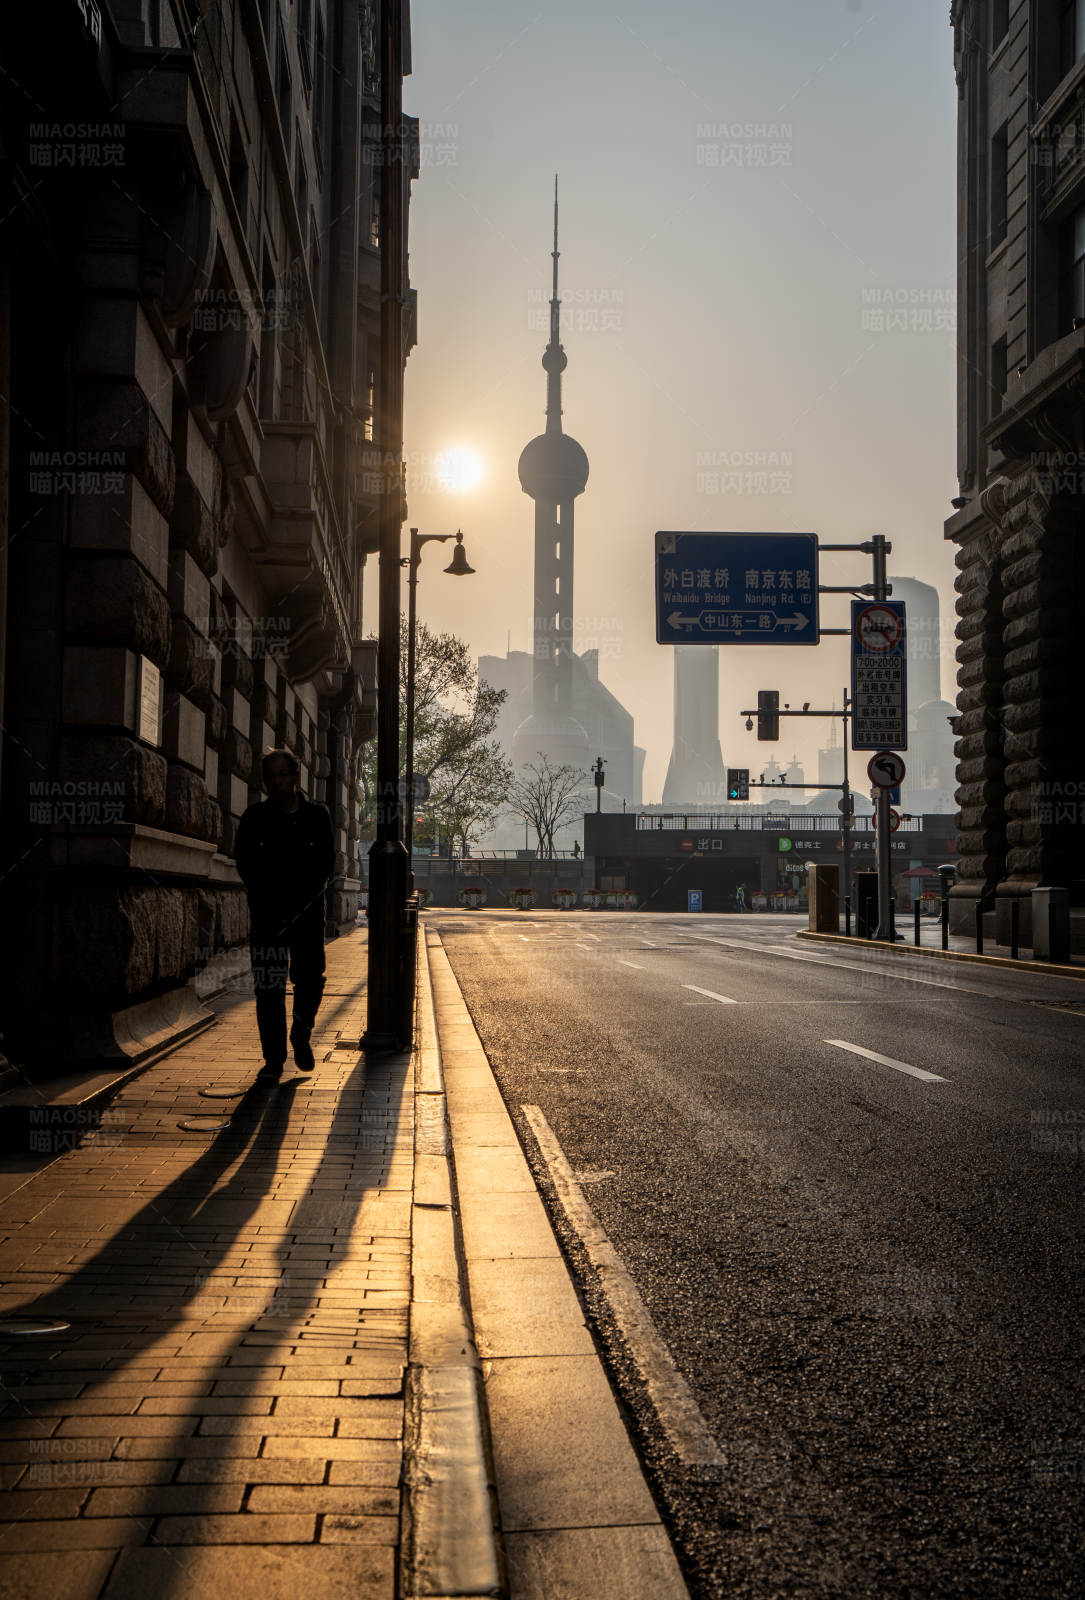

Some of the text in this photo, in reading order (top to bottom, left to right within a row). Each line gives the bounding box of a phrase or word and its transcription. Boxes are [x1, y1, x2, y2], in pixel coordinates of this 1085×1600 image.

[664, 568, 811, 590] 外白渡桥 南京东路
[664, 592, 699, 604] Waibaidu
[705, 592, 730, 606] Bridge
[745, 592, 776, 607] Nanjing
[704, 614, 771, 629] 中山东一路
[866, 695, 892, 705] 实习车
[697, 839, 722, 850] 出口
[691, 893, 700, 905] P
